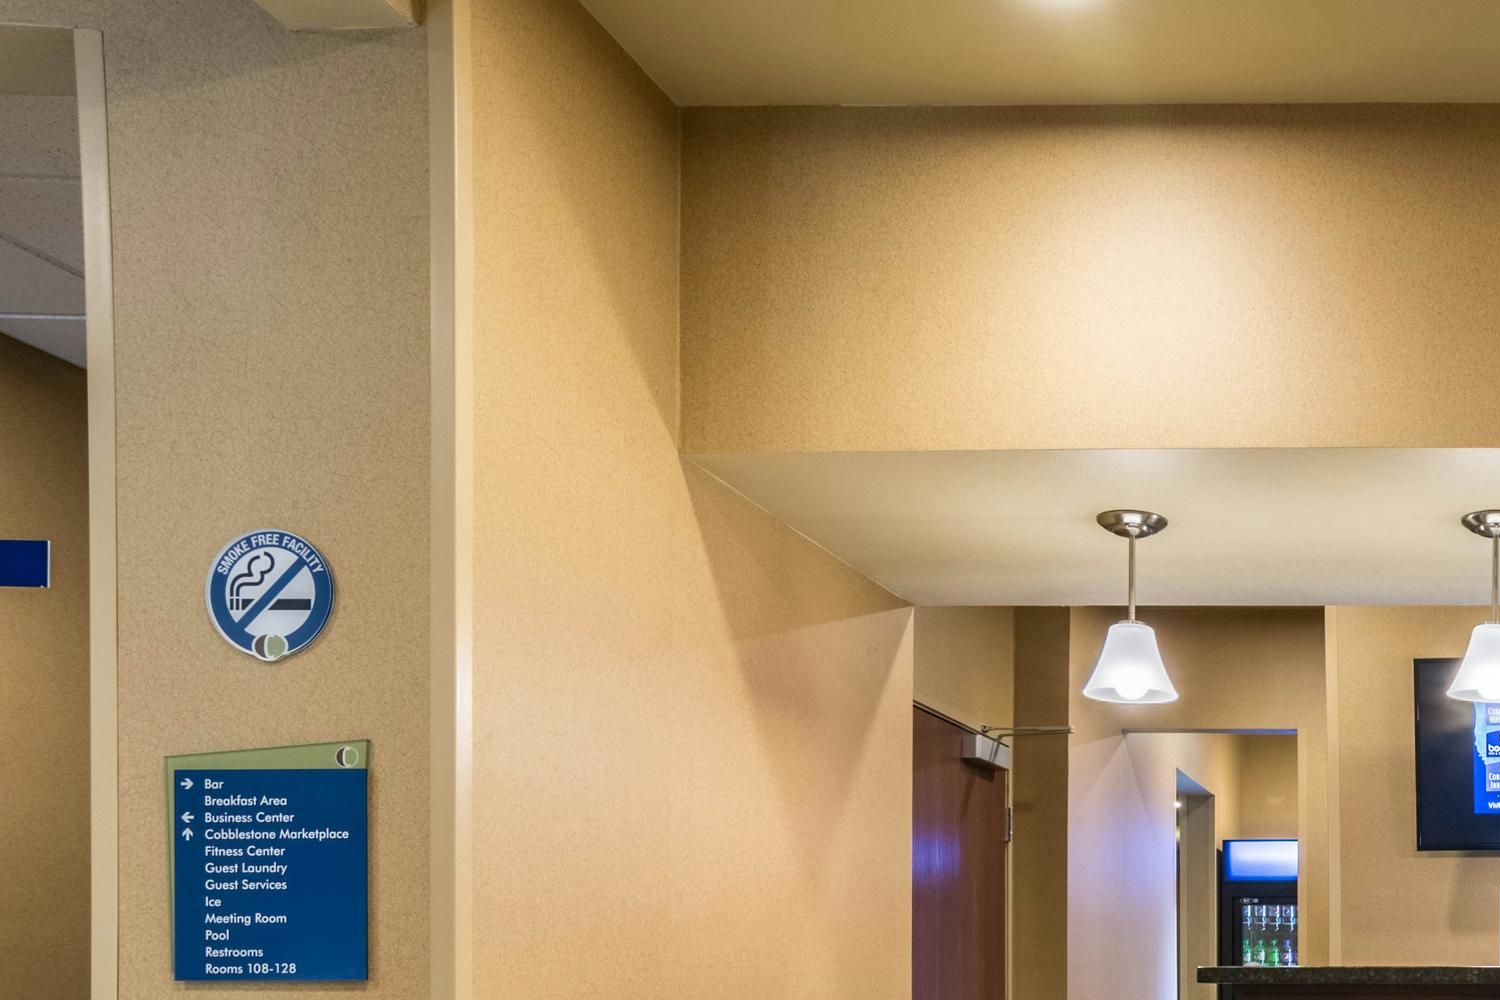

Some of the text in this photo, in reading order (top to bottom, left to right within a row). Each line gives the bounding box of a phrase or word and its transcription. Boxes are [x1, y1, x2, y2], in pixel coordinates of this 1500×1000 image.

[218, 534, 324, 575] SMOKE FREE FACILITY
[205, 779, 224, 789] Bar
[205, 795, 287, 806] Breakfast Area
[205, 812, 295, 823] Business Center
[205, 829, 349, 841] Cobblestone Marketplace
[205, 846, 285, 857] Fitness Center
[205, 862, 287, 875] Guest Laundry
[205, 879, 287, 890] Guest Services
[206, 897, 221, 907] Ice
[205, 913, 287, 926] Meeting Room
[206, 930, 229, 941] Pool
[206, 947, 263, 957] Restrooms
[206, 963, 296, 974] Rooms 108-128
